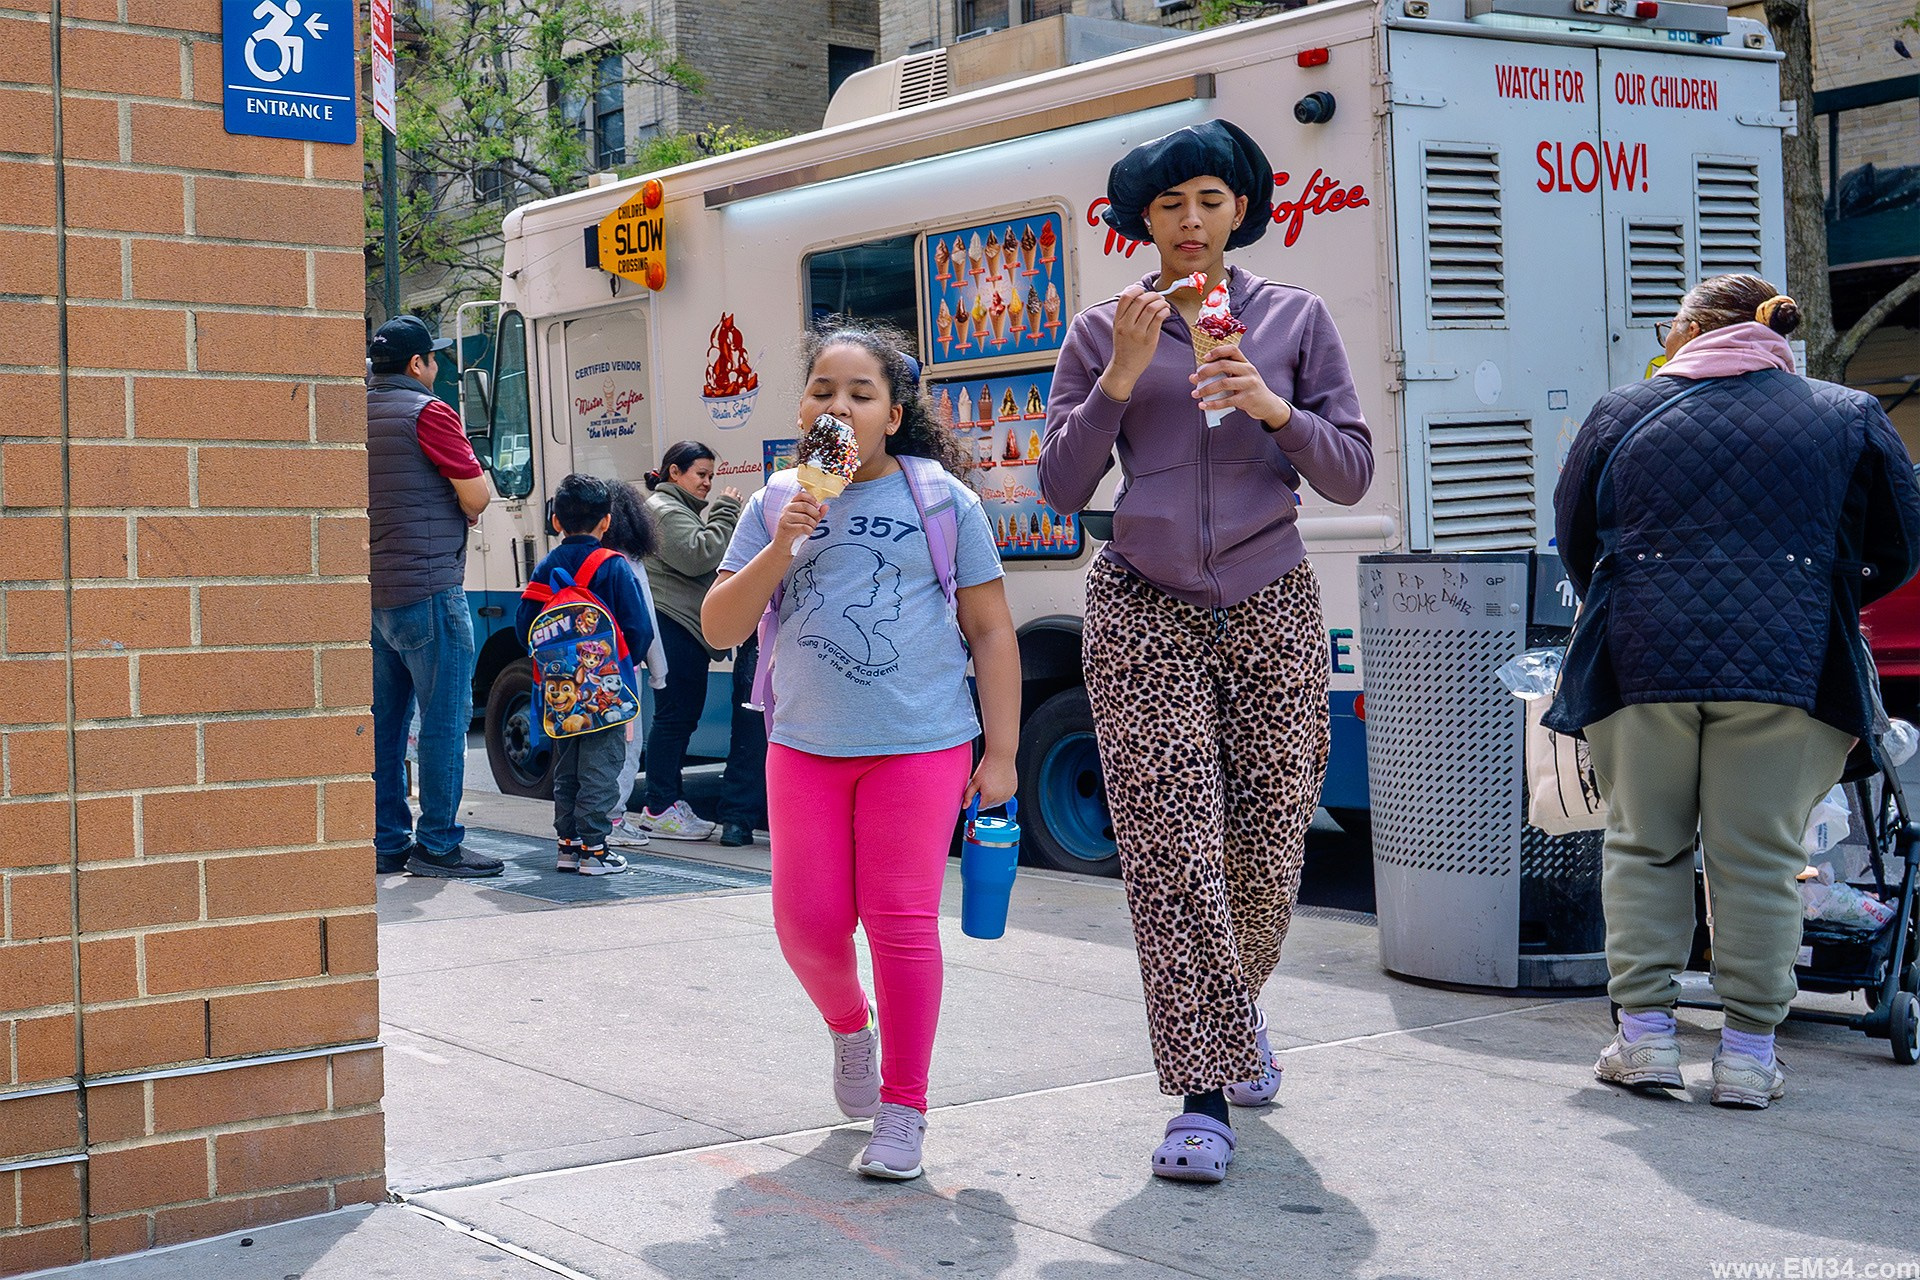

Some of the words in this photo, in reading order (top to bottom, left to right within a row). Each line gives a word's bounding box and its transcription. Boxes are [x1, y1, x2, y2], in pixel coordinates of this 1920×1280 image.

[1495, 64, 1549, 101] WATCH
[1555, 70, 1585, 103] FOR
[1615, 72, 1647, 106] OUR
[1651, 75, 1718, 111] CHILDREN
[247, 98, 333, 121] ENTRANCE
[1536, 140, 1648, 194] SLOW!
[618, 203, 647, 220] CHILDREN
[1270, 168, 1370, 248] oftee
[615, 218, 664, 256] SLOW
[618, 257, 649, 273] CROSSING
[575, 362, 610, 380] CERTIFIED
[611, 361, 642, 372] VENDOR
[575, 397, 604, 415] Mister
[616, 389, 644, 415] Softee
[716, 461, 762, 476] Sundaes
[848, 516, 919, 542] 357
[532, 615, 571, 647] CITY
[818, 653, 829, 661] of
[829, 660, 844, 672] the
[845, 670, 872, 686] Bronx
[823, 642, 851, 665] Voices
[852, 662, 900, 677] Academy
